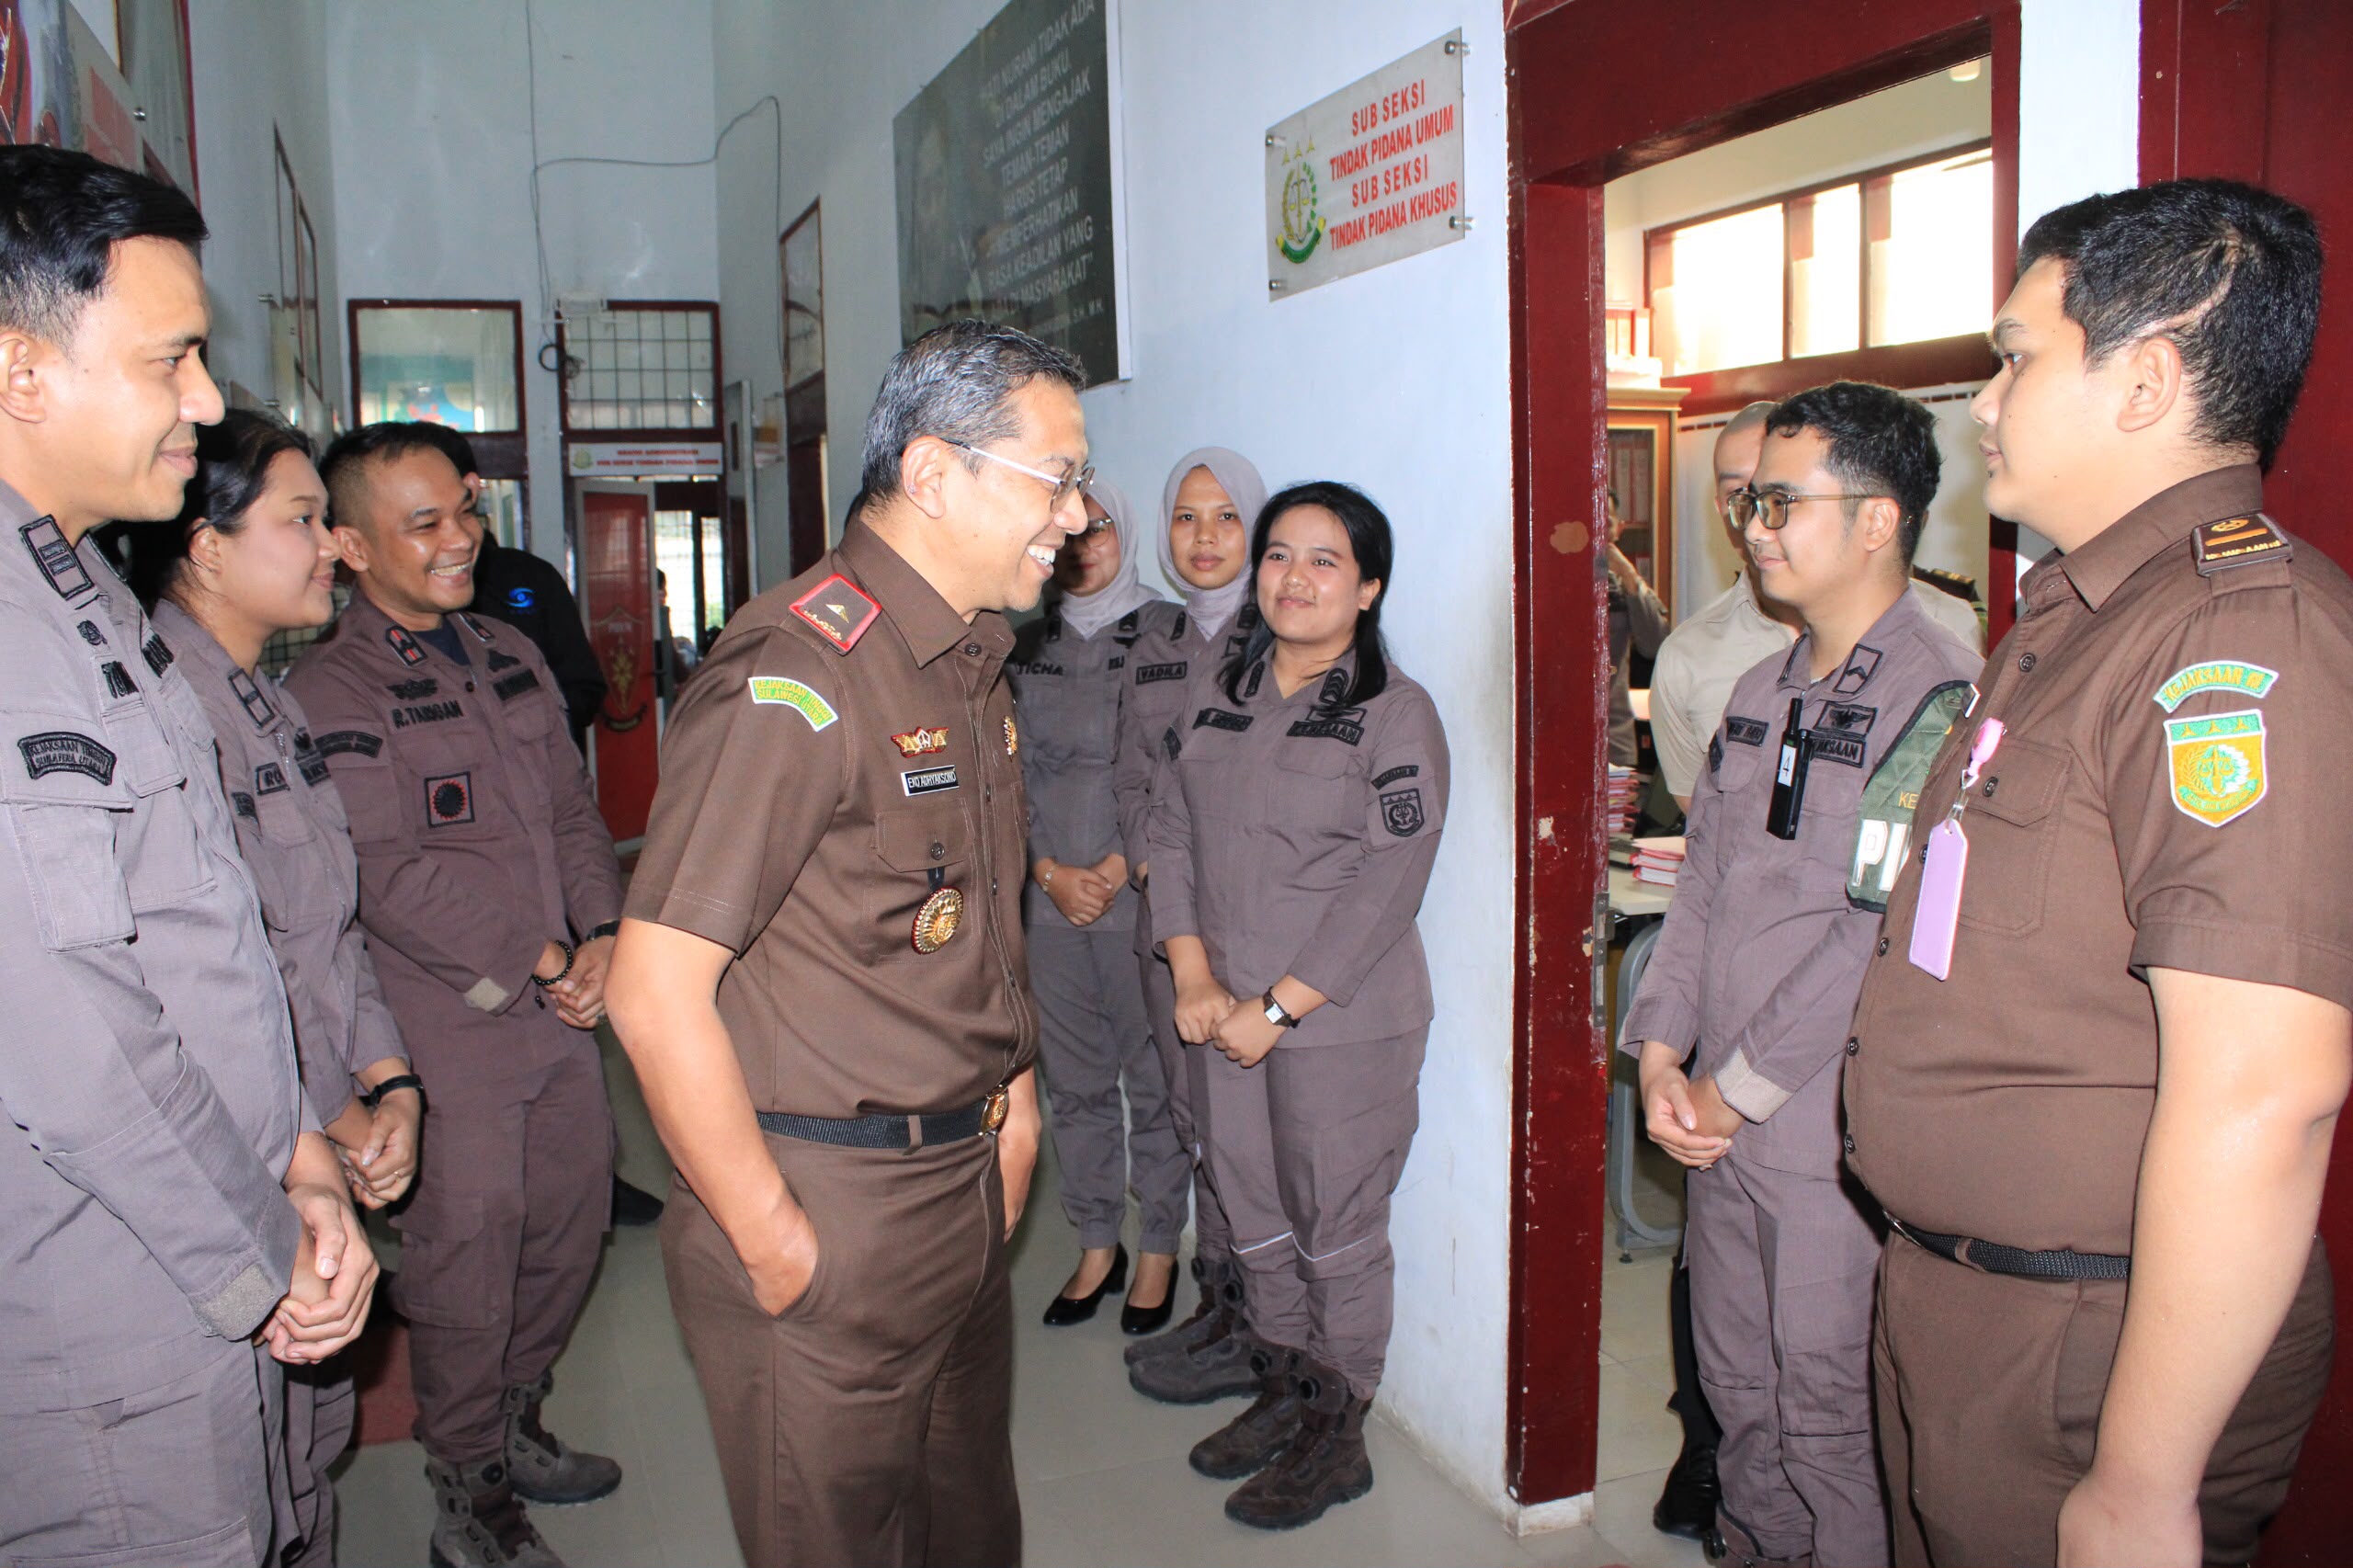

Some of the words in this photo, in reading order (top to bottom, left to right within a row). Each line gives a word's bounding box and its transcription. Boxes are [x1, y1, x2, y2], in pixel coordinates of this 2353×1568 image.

[1070, 0, 1095, 29] ADA
[1032, 66, 1092, 133] MENGAJAK
[1351, 102, 1378, 137] SUB
[1382, 79, 1426, 122] SEKSI
[1001, 119, 1070, 187] TEMAN-TEMAN
[1329, 147, 1370, 182] TINDAK
[1370, 123, 1414, 166] PIDANA
[1415, 104, 1454, 145] UMUM
[1036, 156, 1068, 197] TETAP
[1351, 175, 1379, 208] SUB
[1383, 153, 1428, 196] SEKSI
[1329, 218, 1366, 251] TINDAK
[1368, 198, 1407, 237] PIDANA
[1410, 181, 1458, 224] KHUSUS
[1013, 232, 1062, 279] KEADILAN
[1062, 214, 1094, 253] YANG
[755, 679, 808, 697] KEJAKSAAN
[2163, 665, 2244, 702] KEJAKSAAN
[907, 777, 921, 789] EKO
[1782, 755, 1791, 777] 4
